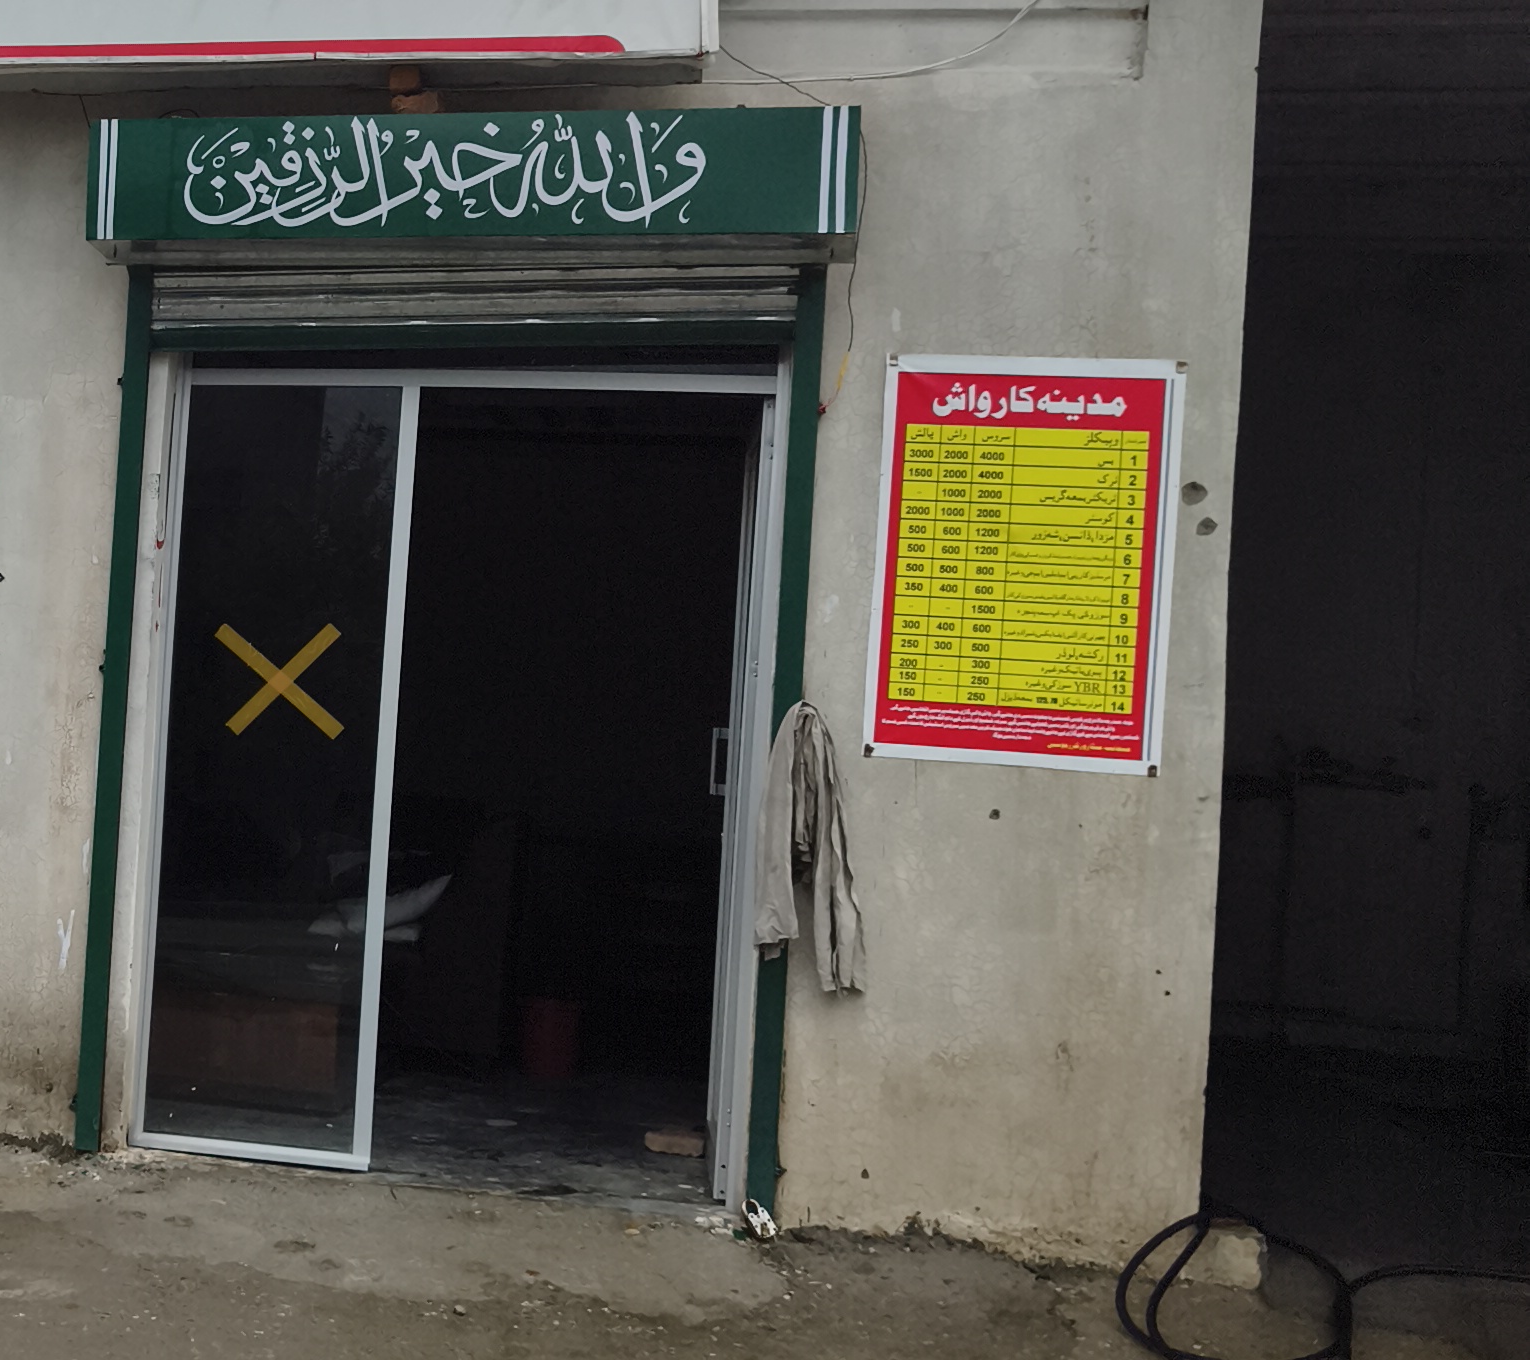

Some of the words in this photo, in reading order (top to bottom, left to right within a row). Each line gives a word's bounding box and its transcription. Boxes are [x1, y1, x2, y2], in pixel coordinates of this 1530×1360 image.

[932, 382, 992, 419] واش
[990, 385, 1037, 419] کار
[1037, 389, 1128, 421] مدینہ
[947, 429, 968, 441] واش
[908, 448, 935, 459] 3000
[943, 449, 969, 460] 2000
[979, 451, 1005, 462] 4000
[1130, 454, 1138, 467] 1
[908, 467, 933, 479] 1500
[942, 468, 968, 479] 2000
[977, 470, 1004, 481] 4000
[1128, 474, 1138, 487] 2
[941, 488, 967, 499] 1000
[977, 489, 1003, 500] 2000
[1127, 494, 1136, 507] 3
[905, 505, 931, 516] 2000
[940, 507, 965, 518] 1000
[975, 508, 1002, 519] 2000
[1125, 514, 1135, 526] 4
[907, 524, 927, 535] 500
[942, 525, 962, 536] 600
[974, 527, 1001, 538] 1200
[1124, 533, 1134, 546] 5
[906, 543, 926, 553] 500
[940, 544, 961, 555] 600
[974, 545, 999, 556] 1200
[1123, 553, 1132, 566] 6
[905, 562, 925, 573] 500
[938, 564, 959, 575] 500
[975, 565, 995, 576] 800
[1122, 573, 1131, 586] 7
[938, 583, 959, 594] 400
[974, 585, 994, 596] 600
[1120, 593, 1130, 606] 8
[971, 604, 996, 615] 1500
[1119, 612, 1129, 625] 9
[901, 619, 921, 630] 300
[935, 621, 956, 632] 400
[971, 623, 992, 634] 600
[900, 638, 920, 649] 250
[933, 640, 953, 651] 300
[1114, 634, 1130, 647] 10
[971, 642, 991, 653] 500
[898, 657, 917, 668] 200
[971, 658, 991, 669] 300
[1114, 652, 1128, 664] 11
[898, 670, 917, 681] 150
[1112, 670, 1127, 681] 12
[970, 676, 990, 687] 250
[897, 686, 916, 697] 150
[1073, 681, 1102, 694] YBR
[1111, 684, 1126, 695] 13
[966, 691, 986, 702] 250
[1109, 702, 1125, 713] 14
